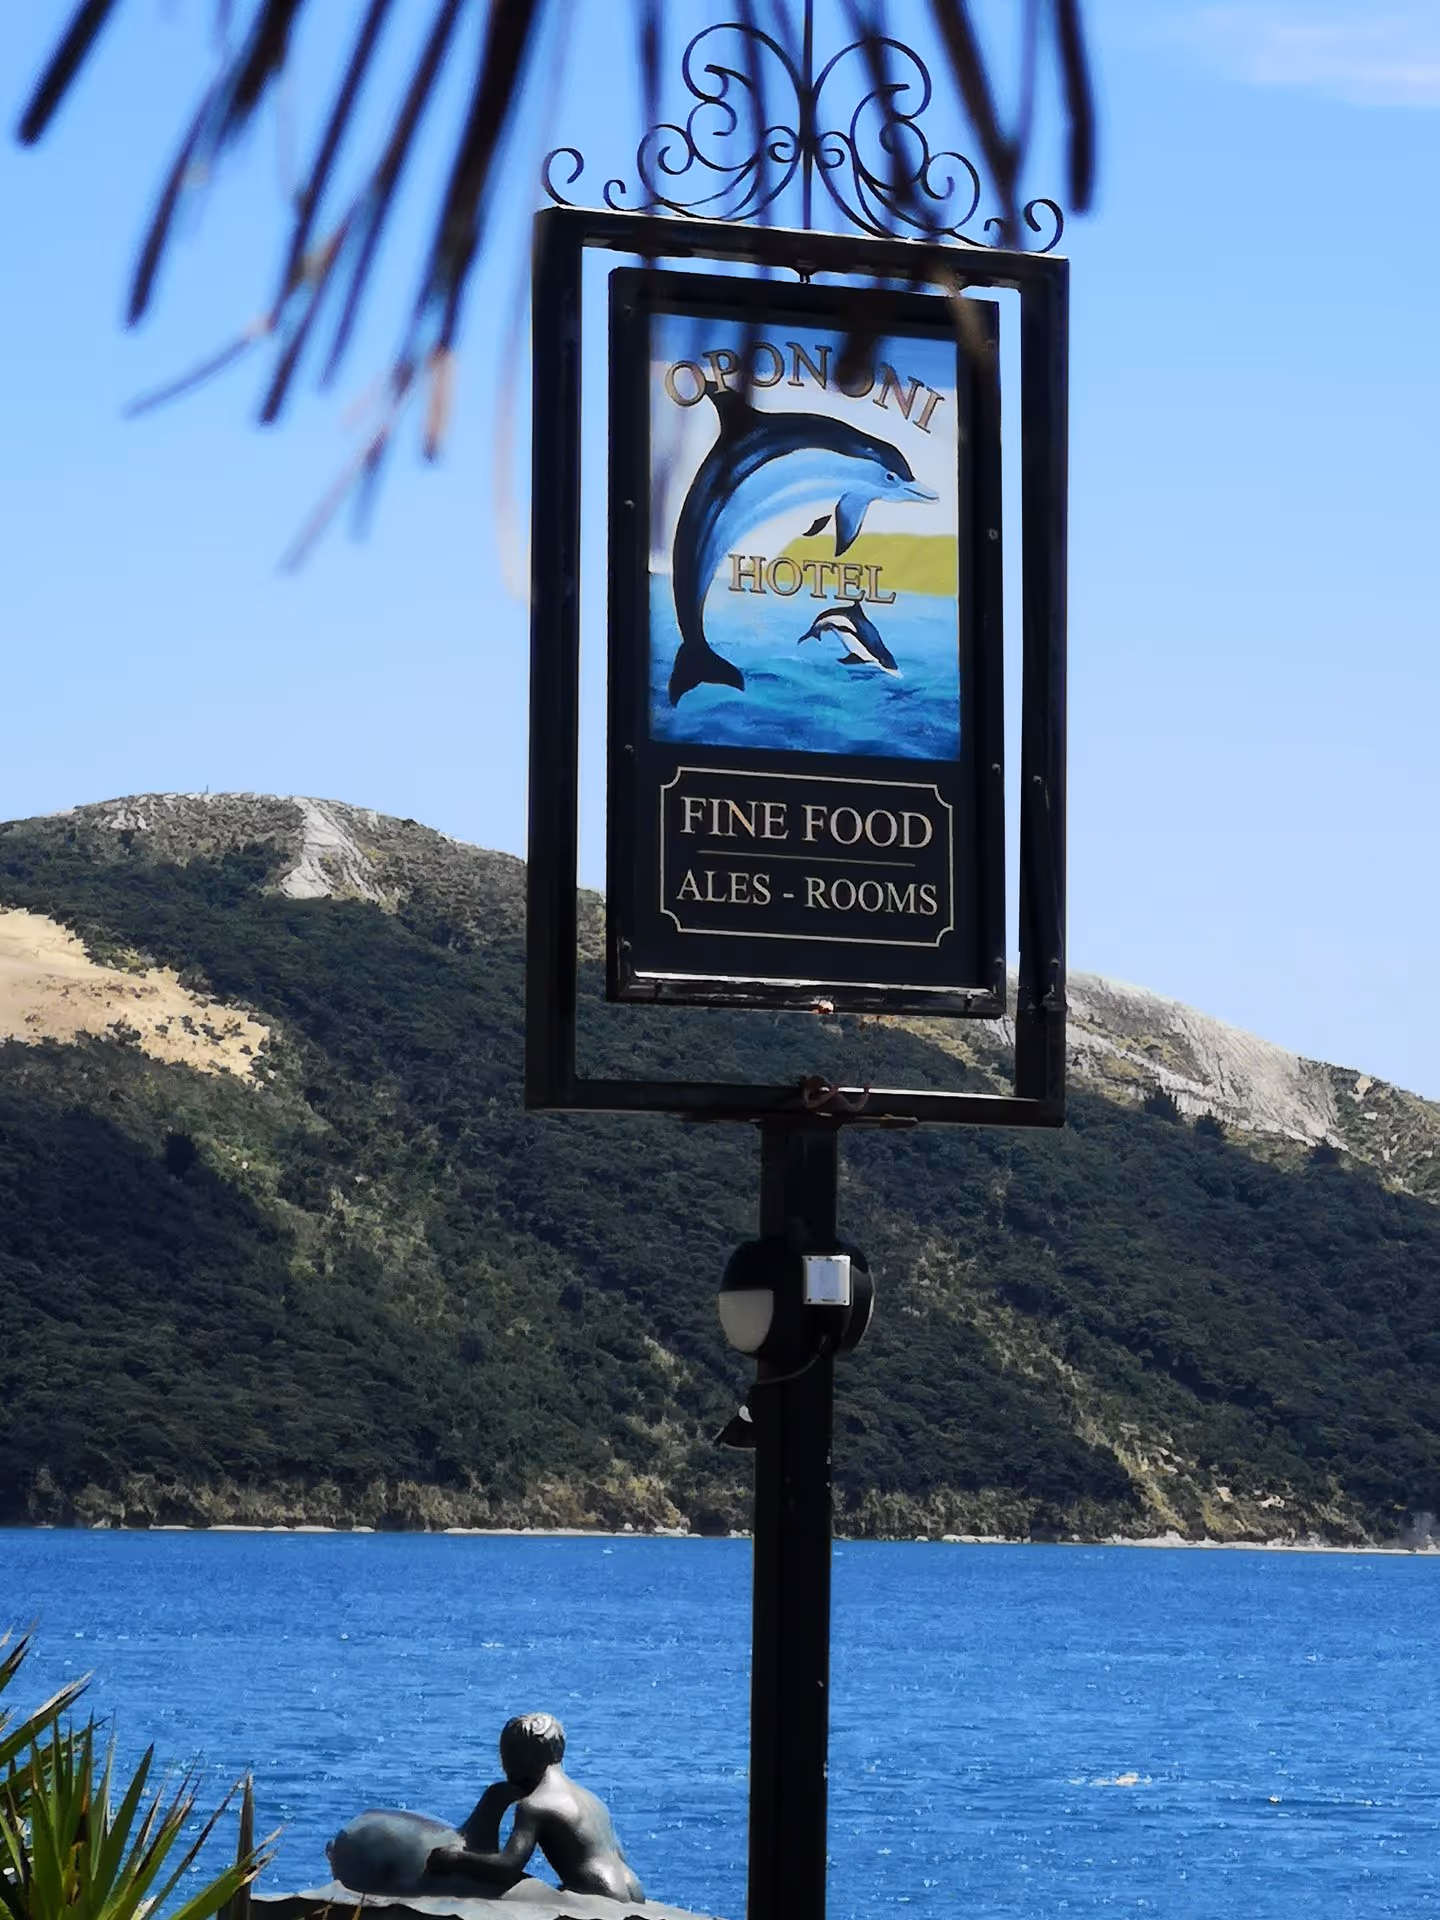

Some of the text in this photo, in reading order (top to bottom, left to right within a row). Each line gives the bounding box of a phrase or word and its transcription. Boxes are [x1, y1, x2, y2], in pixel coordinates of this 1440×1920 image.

[728, 554, 896, 604] HOTEL
[679, 796, 933, 848] FINE FOOD
[676, 869, 772, 905] ALES
[804, 876, 938, 916] ROOMS
